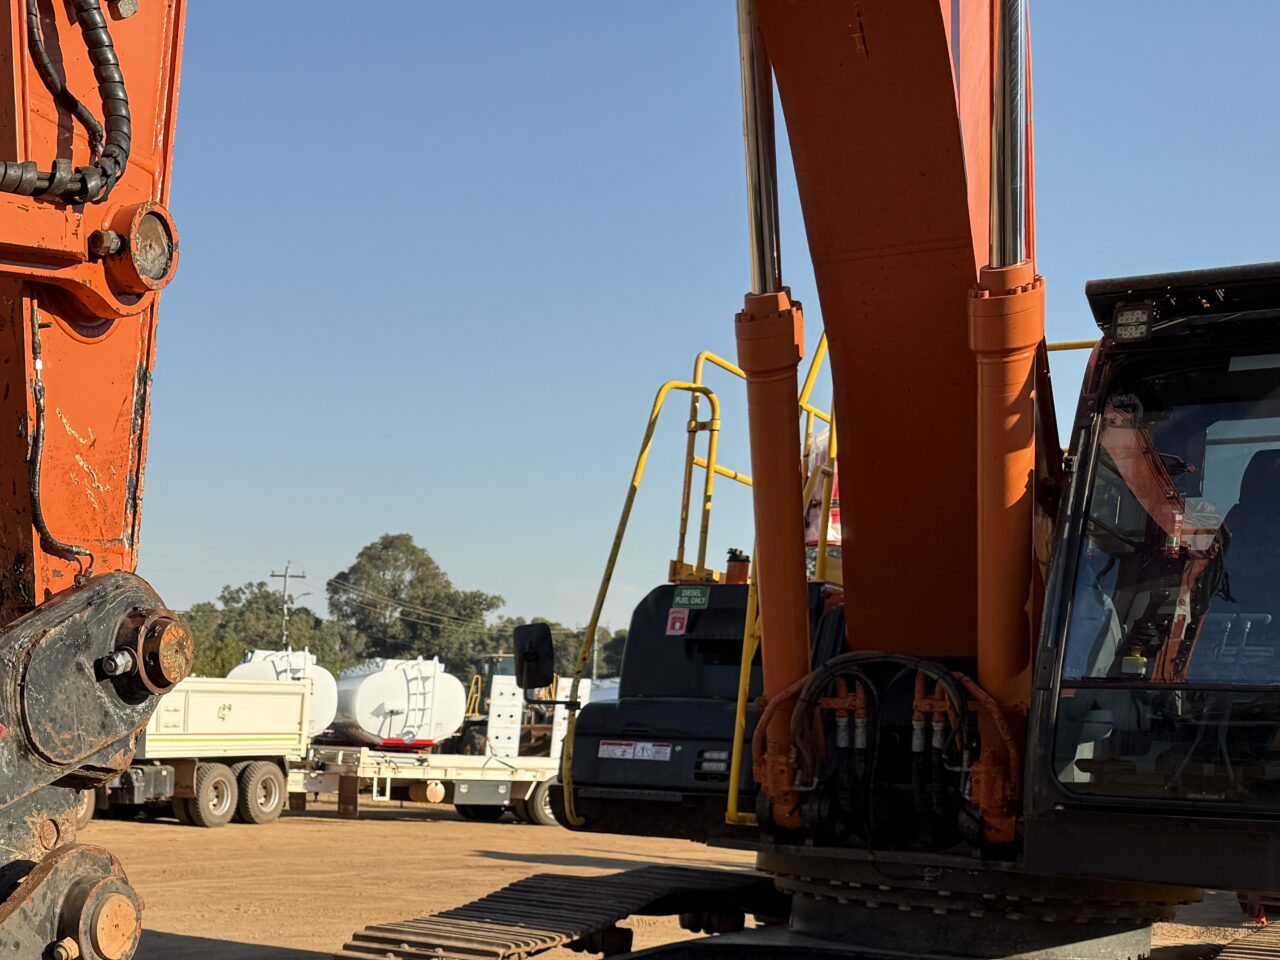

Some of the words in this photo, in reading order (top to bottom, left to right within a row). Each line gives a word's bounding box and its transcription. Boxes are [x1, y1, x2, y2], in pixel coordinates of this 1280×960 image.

[681, 589, 702, 597] DIESEL
[674, 596, 689, 604] FUEL
[690, 597, 706, 605] ONLY
